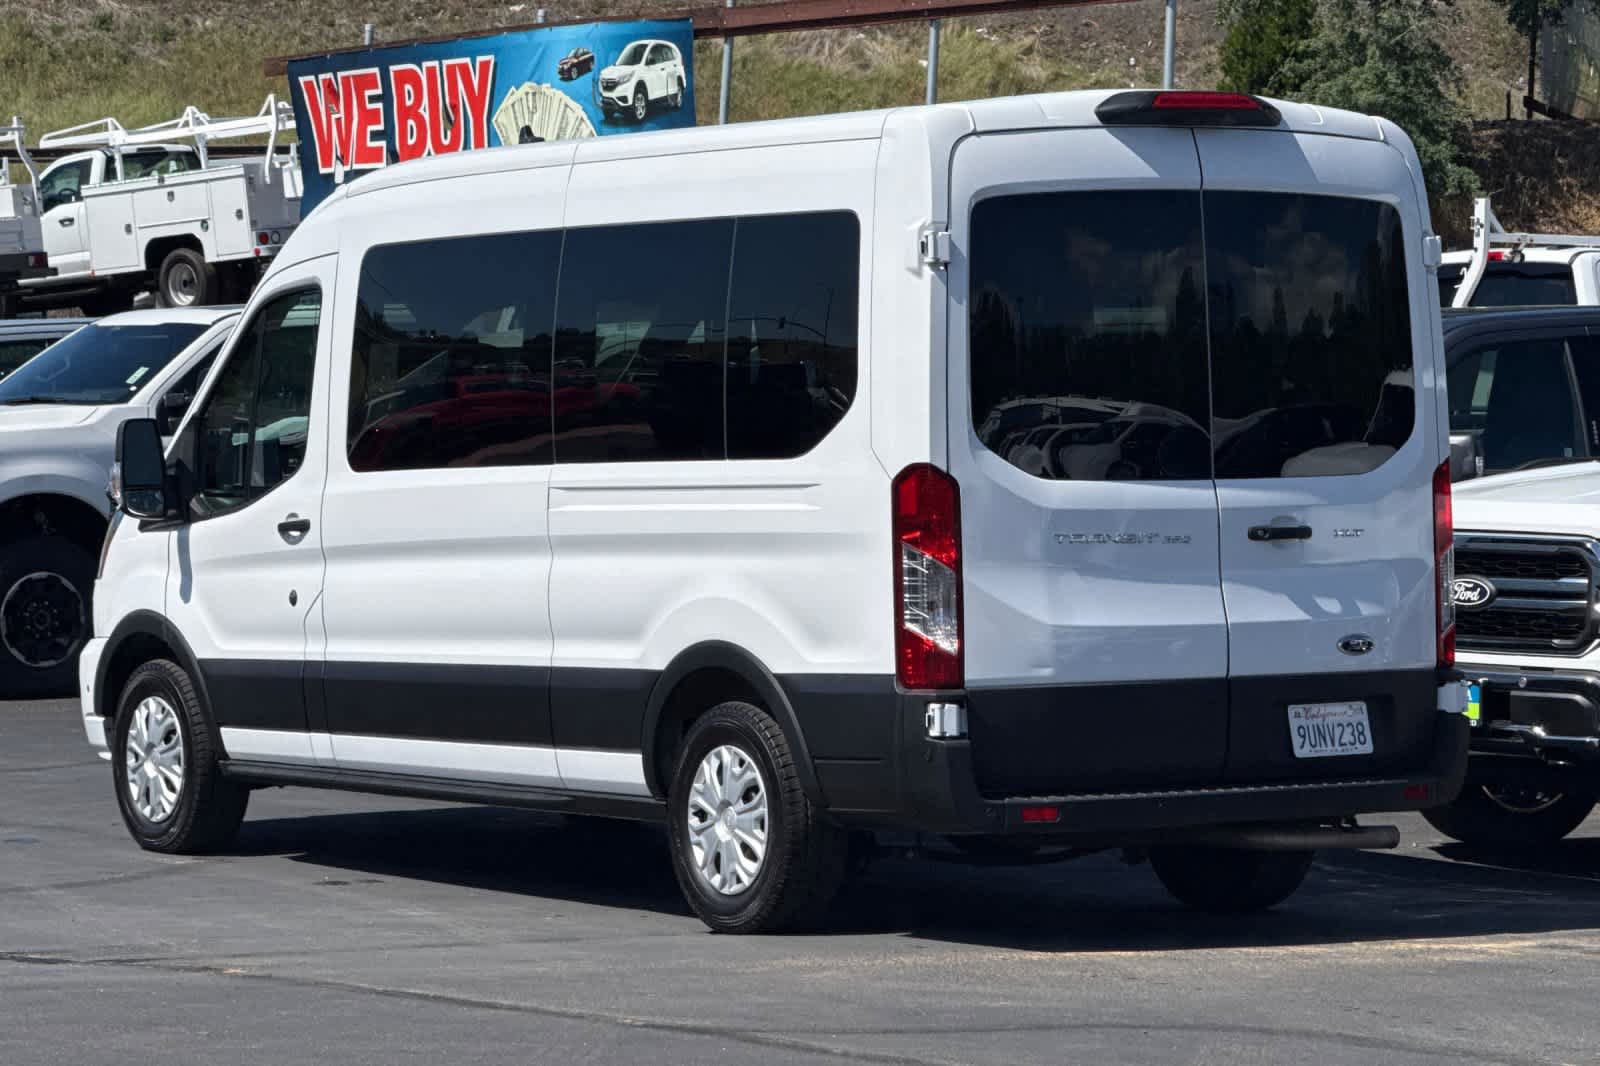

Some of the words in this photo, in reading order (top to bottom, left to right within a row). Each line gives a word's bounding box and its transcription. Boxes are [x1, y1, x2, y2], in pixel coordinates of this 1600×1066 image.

[299, 68, 387, 173] WE
[390, 55, 494, 162] BUY
[1454, 581, 1481, 601] Ford
[1297, 721, 1367, 749] 9UNV238
